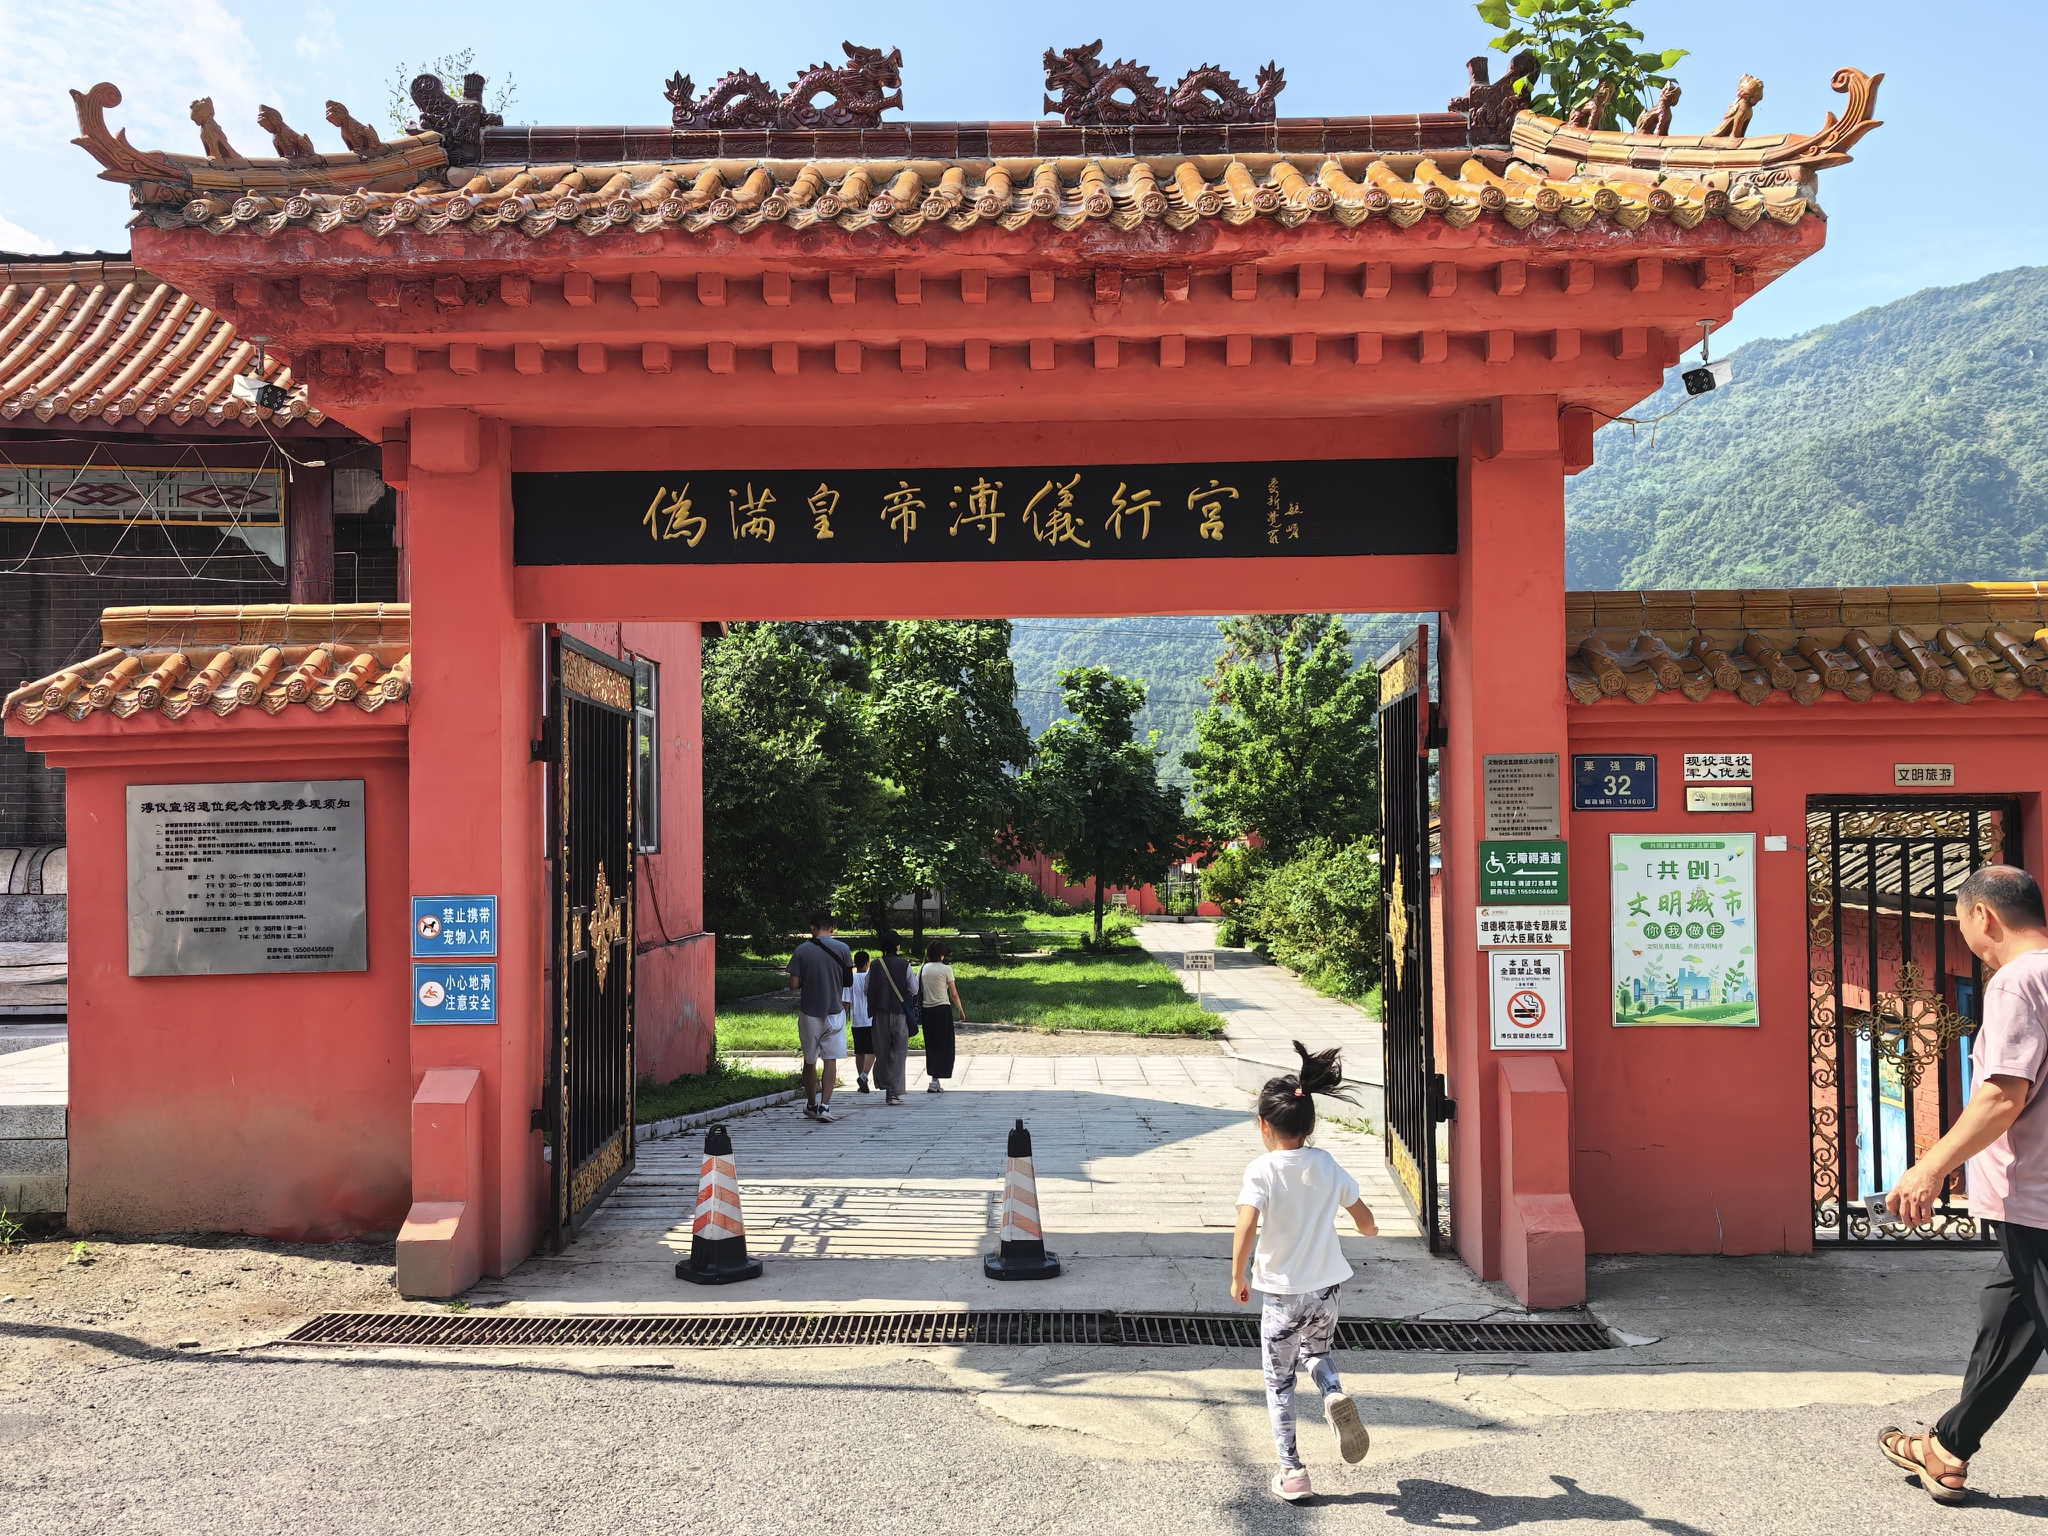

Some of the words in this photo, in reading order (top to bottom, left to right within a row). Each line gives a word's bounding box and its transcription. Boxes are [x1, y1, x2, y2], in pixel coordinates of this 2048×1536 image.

[1685, 755, 1752, 767] 现役退役
[1685, 767, 1752, 779] 军人优先
[1897, 768, 1952, 781] 文明旅游
[1603, 775, 1632, 796] 32
[140, 798, 351, 814] 溥仪宣诏退位纪念馆免费参观须知
[1506, 851, 1562, 865] 无障碍通道
[1627, 889, 1743, 918] 文明城市
[442, 906, 491, 924] 禁止携带
[1480, 920, 1568, 932] 道德模范事迹专题展览
[1645, 923, 1723, 937] 你我做起
[442, 928, 490, 945] 宠物入内
[1492, 933, 1553, 944] 在八大臣展区处
[1508, 958, 1542, 967] 本区域
[1500, 967, 1551, 976] 全面禁止吸烟
[444, 974, 491, 991] 小心地滑
[444, 994, 491, 1011] 注意安全
